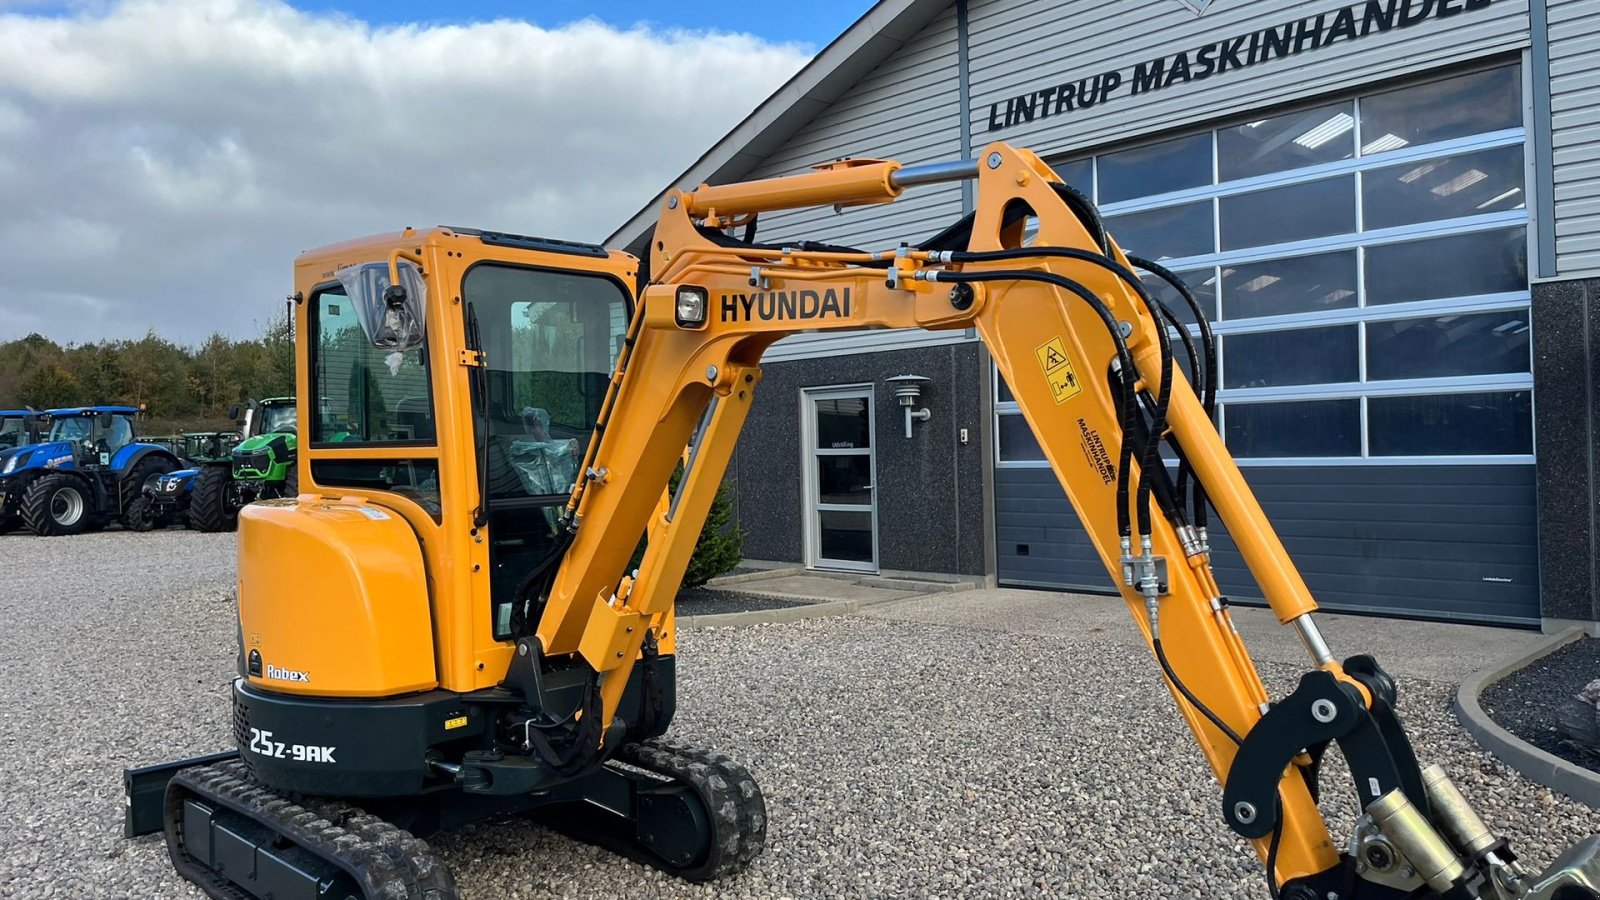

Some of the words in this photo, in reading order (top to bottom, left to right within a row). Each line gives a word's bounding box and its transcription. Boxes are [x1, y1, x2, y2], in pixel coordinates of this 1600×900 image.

[988, 71, 1122, 131] LINTRUP
[1131, 0, 1492, 96] MASKINHAND
[721, 287, 851, 322] HYUNDAI
[1077, 418, 1111, 485] MASKINHANDEL
[1090, 430, 1111, 465] LINTRUP
[267, 664, 311, 682] Robex
[250, 727, 337, 763] 25Z-9AK
